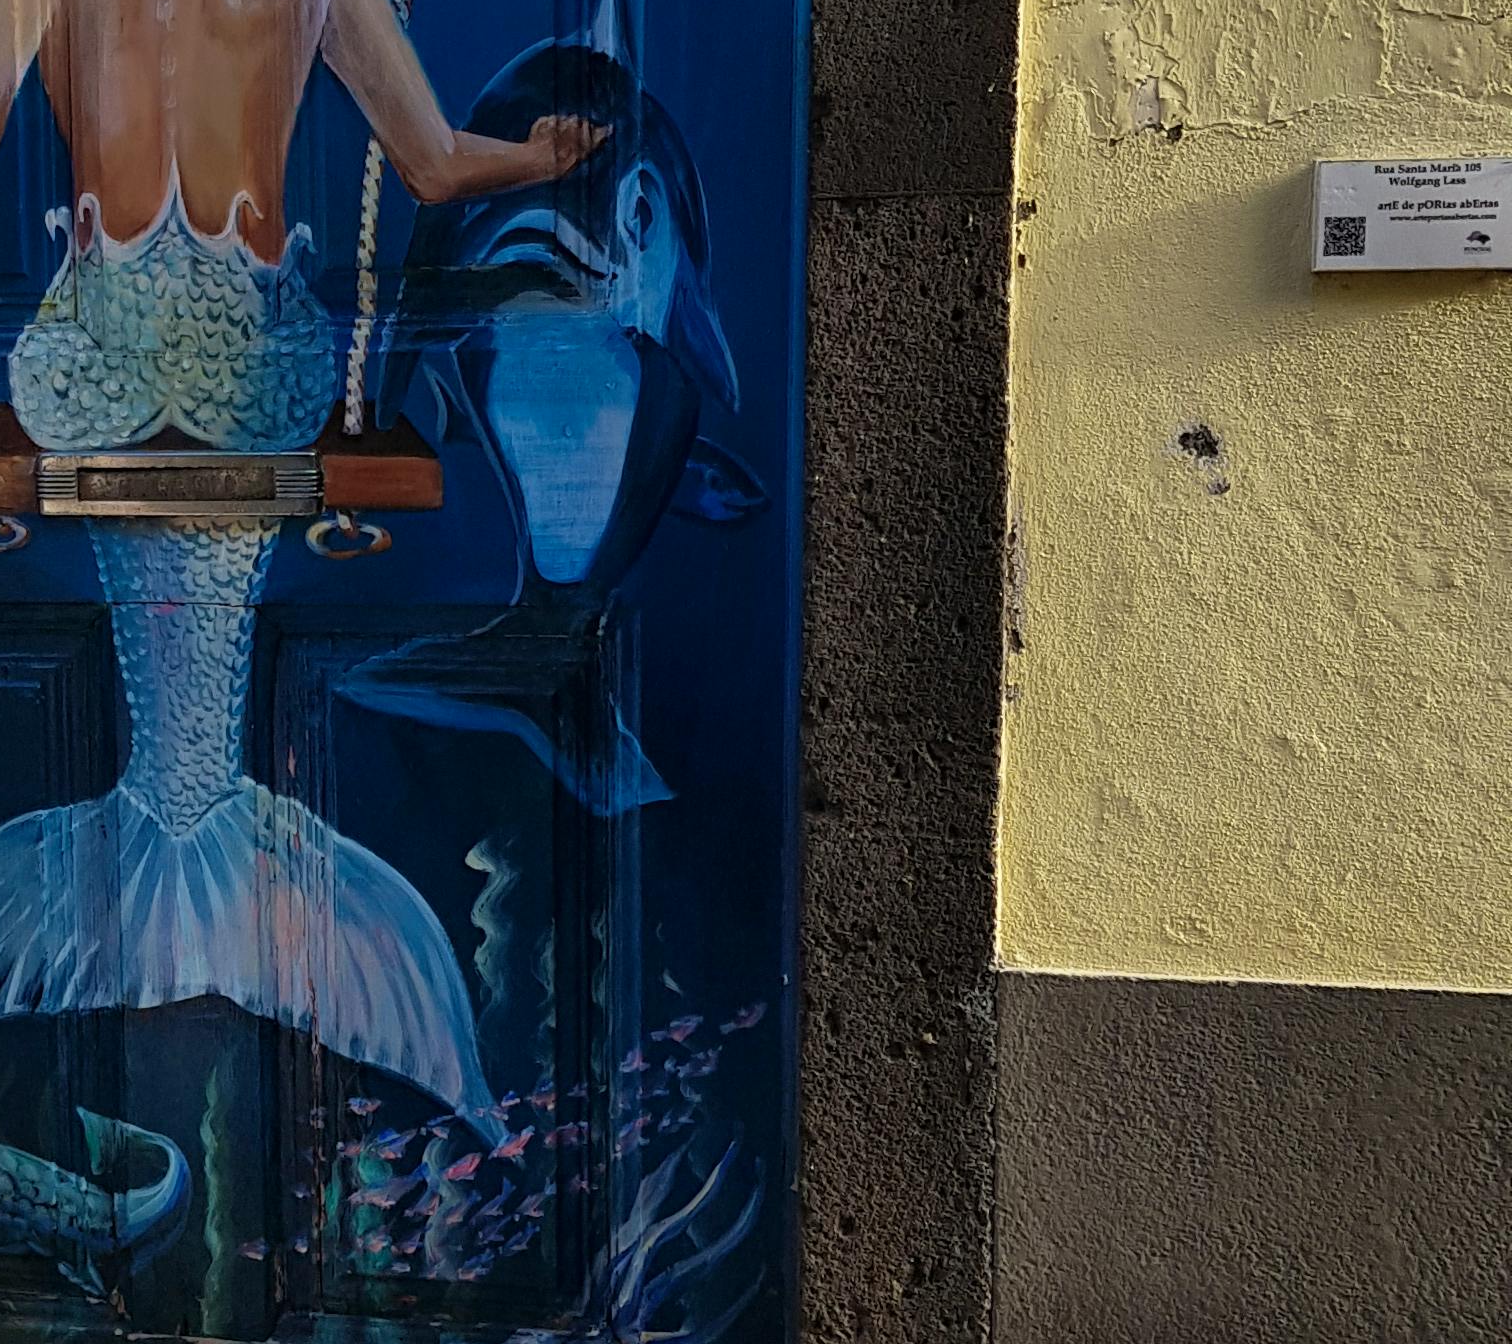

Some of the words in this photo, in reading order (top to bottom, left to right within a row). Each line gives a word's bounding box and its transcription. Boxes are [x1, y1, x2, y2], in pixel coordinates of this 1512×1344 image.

[1374, 165, 1395, 174] Rua
[1398, 164, 1427, 174] Santa
[1464, 163, 1481, 172] 105
[1389, 176, 1440, 187] Wolfgang
[1443, 176, 1466, 185] Lass
[1402, 200, 1415, 210] de
